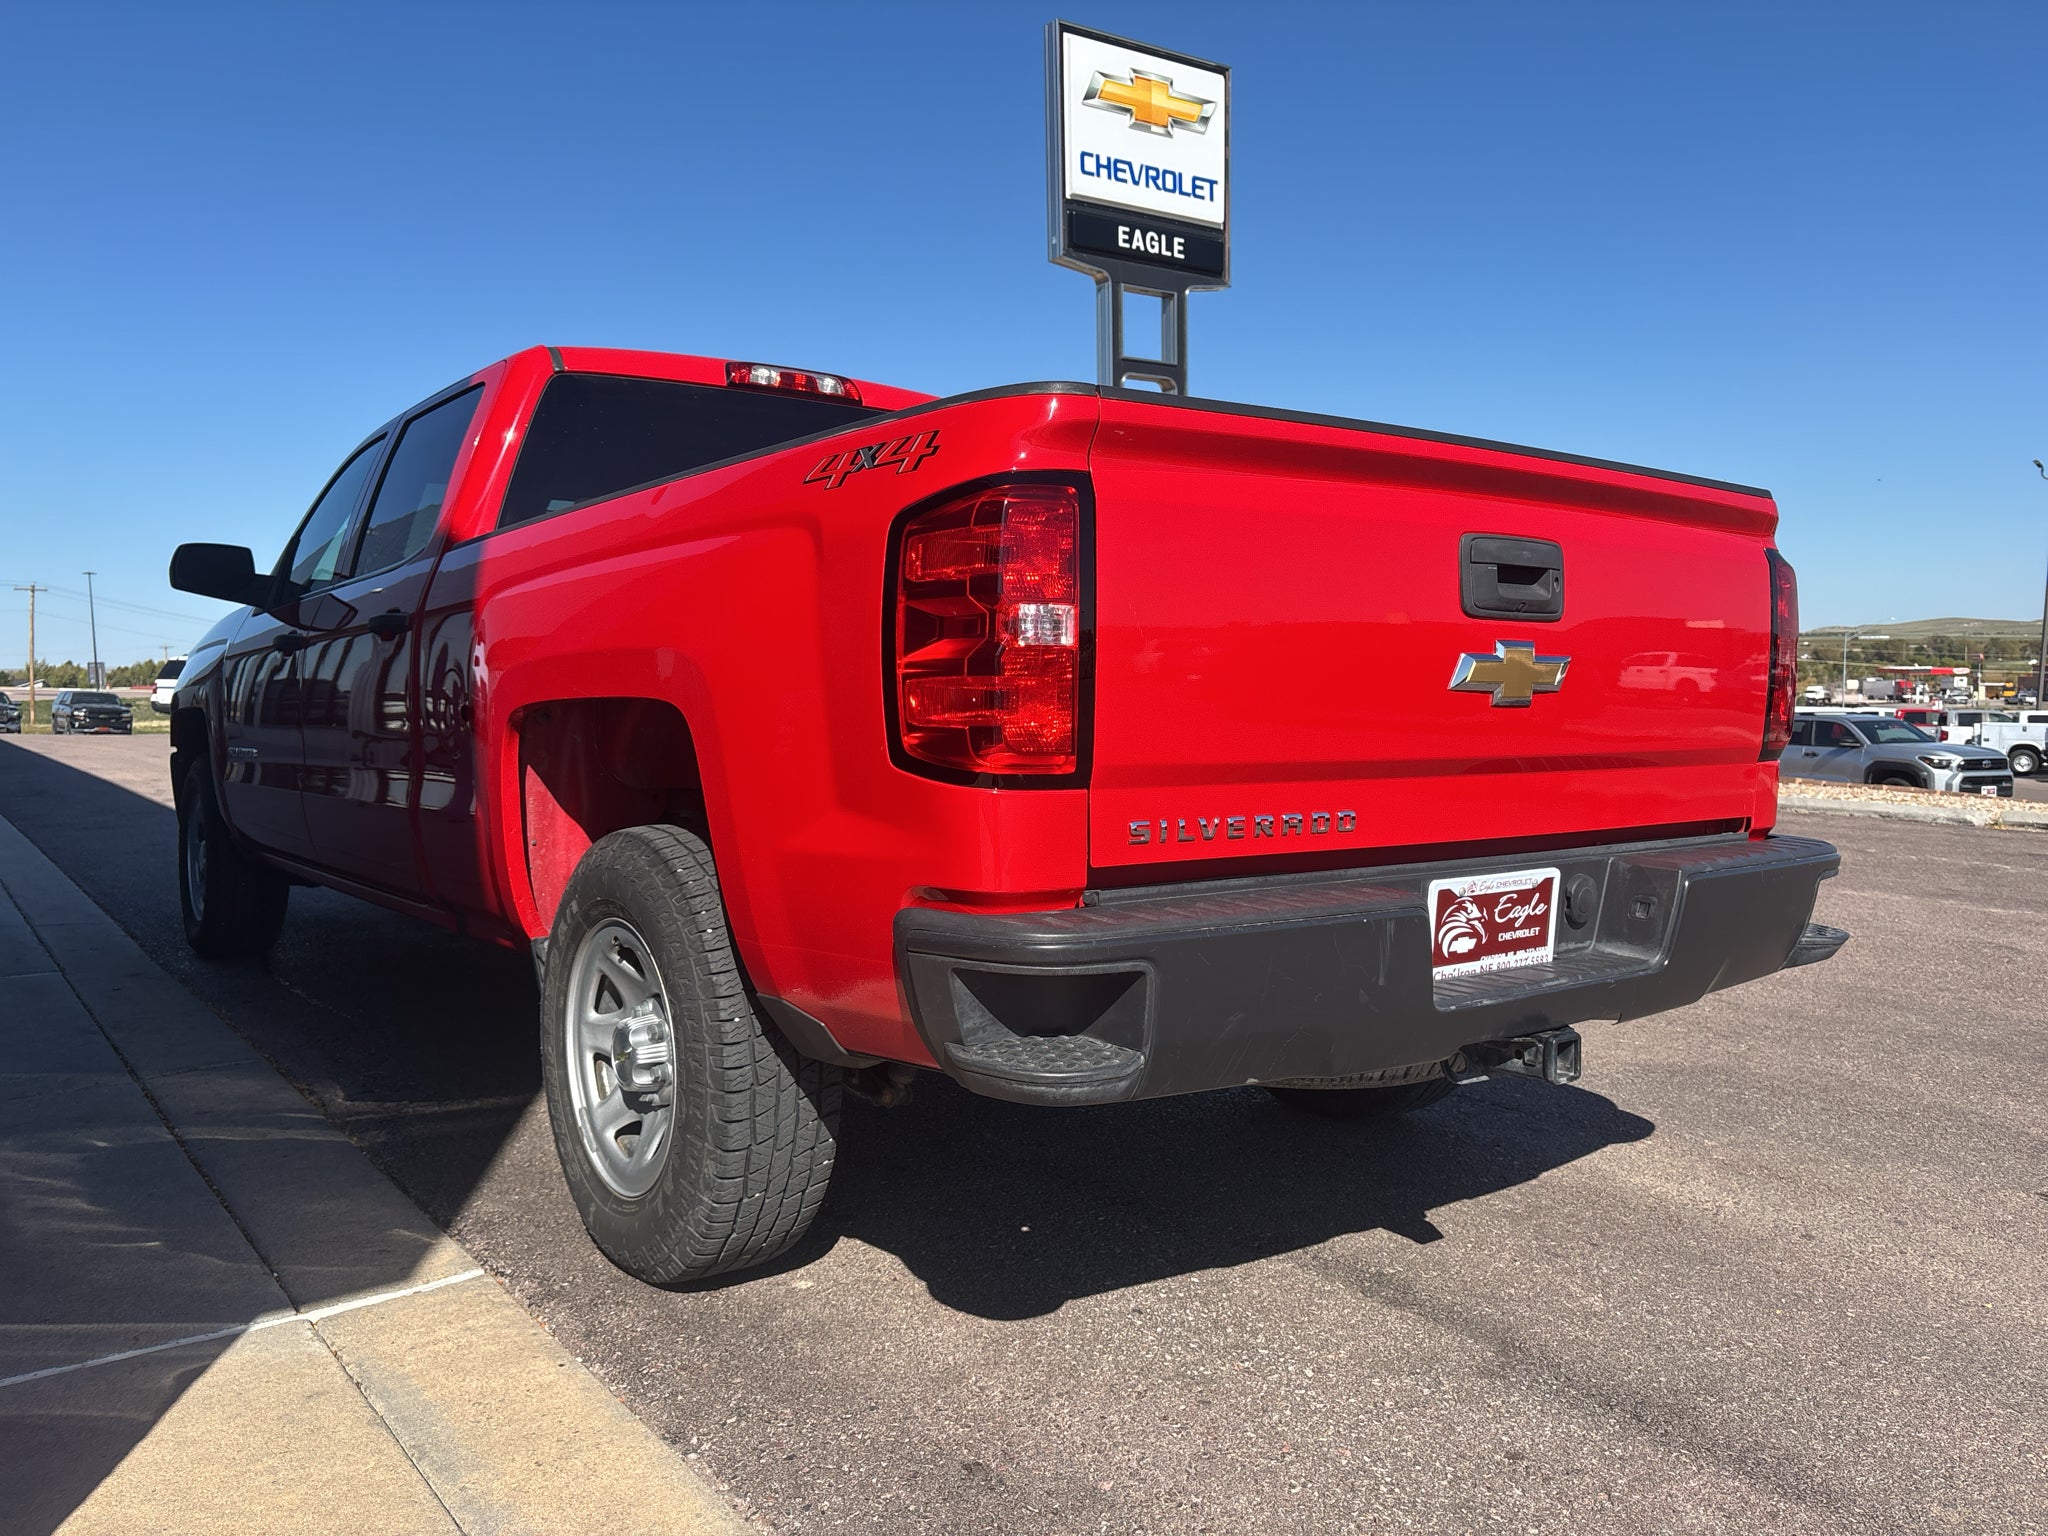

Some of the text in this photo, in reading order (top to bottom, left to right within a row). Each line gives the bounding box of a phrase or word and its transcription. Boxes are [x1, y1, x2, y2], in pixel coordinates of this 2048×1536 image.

[1079, 150, 1218, 202] CHEVROLET
[1117, 225, 1186, 260] EAGLE
[1128, 810, 1357, 845] SILVERADO
[1494, 892, 1548, 928] Eagle
[1498, 927, 1541, 942] CHEVROLET
